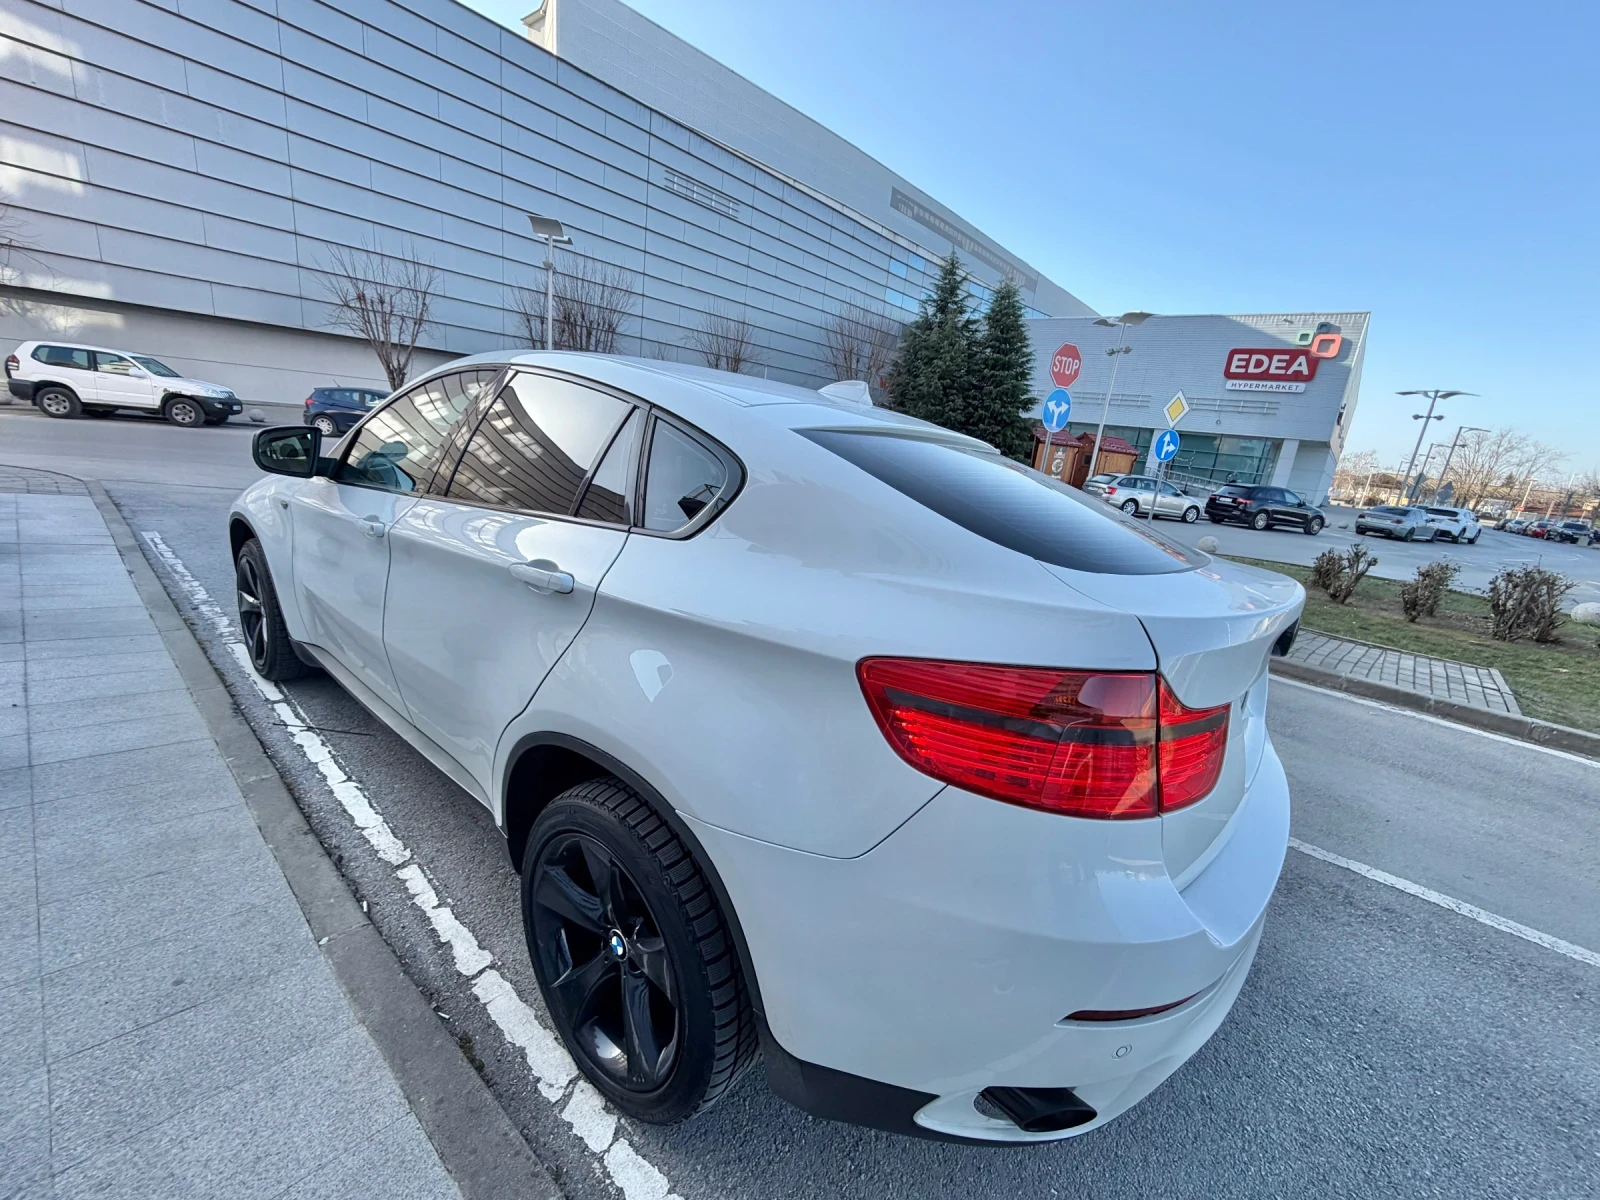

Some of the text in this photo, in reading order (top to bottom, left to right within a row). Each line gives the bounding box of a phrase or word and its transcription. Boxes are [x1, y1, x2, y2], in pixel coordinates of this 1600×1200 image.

[1053, 355, 1080, 376] STOP
[1229, 353, 1308, 375] EDEA
[1231, 382, 1300, 391] HYPERMARKET
